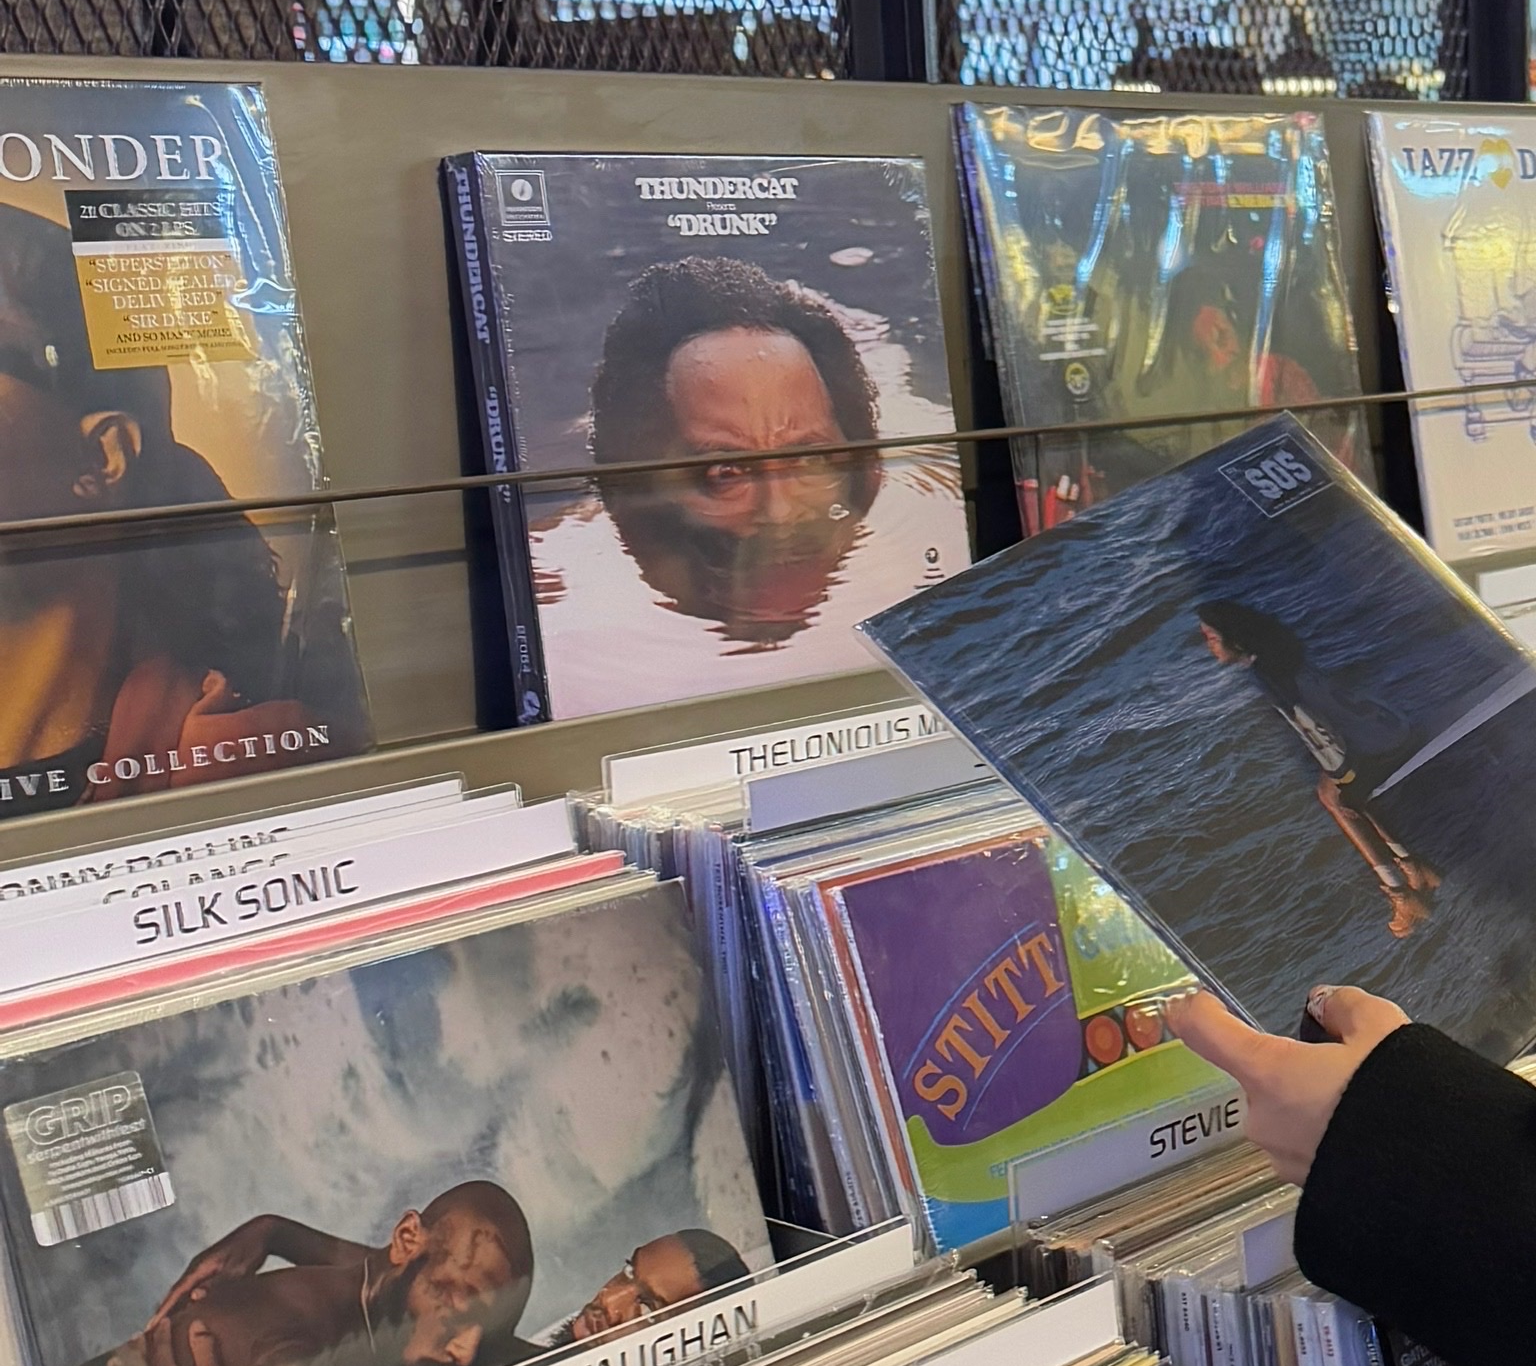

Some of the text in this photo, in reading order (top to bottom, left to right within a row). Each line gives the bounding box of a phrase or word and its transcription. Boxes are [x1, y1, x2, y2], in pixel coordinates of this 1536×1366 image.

[635, 176, 799, 200] THUNDERCAT
[1402, 147, 1479, 181] JAZZ
[99, 201, 176, 219] CLASSIC
[180, 201, 221, 216] HITS
[115, 221, 147, 238] ON
[455, 166, 490, 345] THUNDERCAT
[116, 333, 142, 344] AND
[143, 332, 159, 343] SO
[1244, 448, 1313, 500] SOS
[86, 724, 331, 785] COLLECTION
[729, 716, 911, 775] THELONIOUS
[133, 892, 229, 946] SILK
[235, 859, 360, 921] SONIC
[912, 931, 1073, 1123] STITT
[25, 1085, 132, 1146] GRIP
[1149, 1098, 1240, 1159] STEVIE
